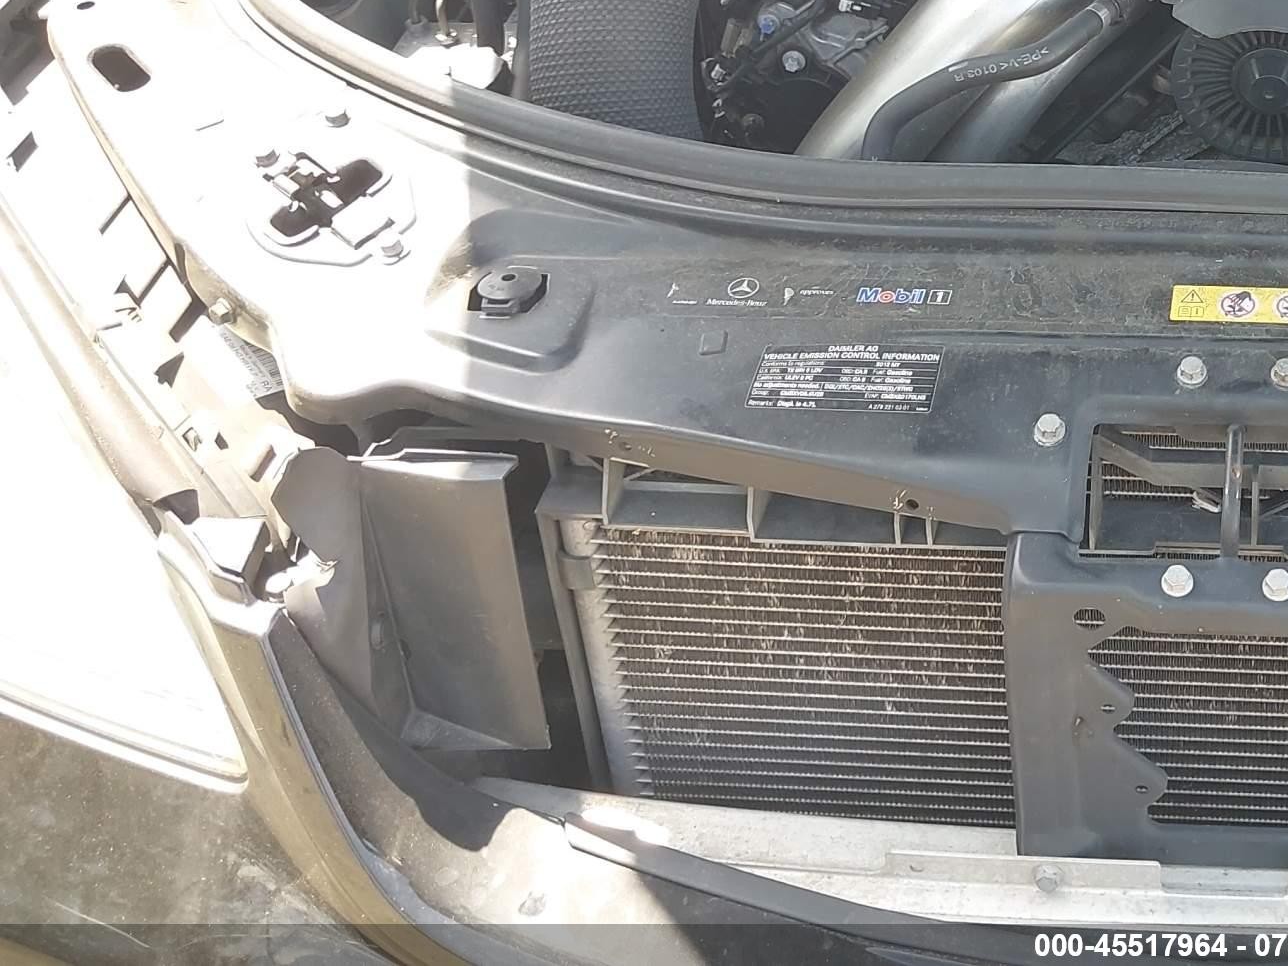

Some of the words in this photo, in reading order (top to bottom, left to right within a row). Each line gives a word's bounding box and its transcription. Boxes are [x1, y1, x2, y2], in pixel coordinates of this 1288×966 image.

[856, 287, 926, 304] Mobil
[706, 298, 767, 307] Mercedes-Benz
[882, 353, 940, 361] INFORMATION
